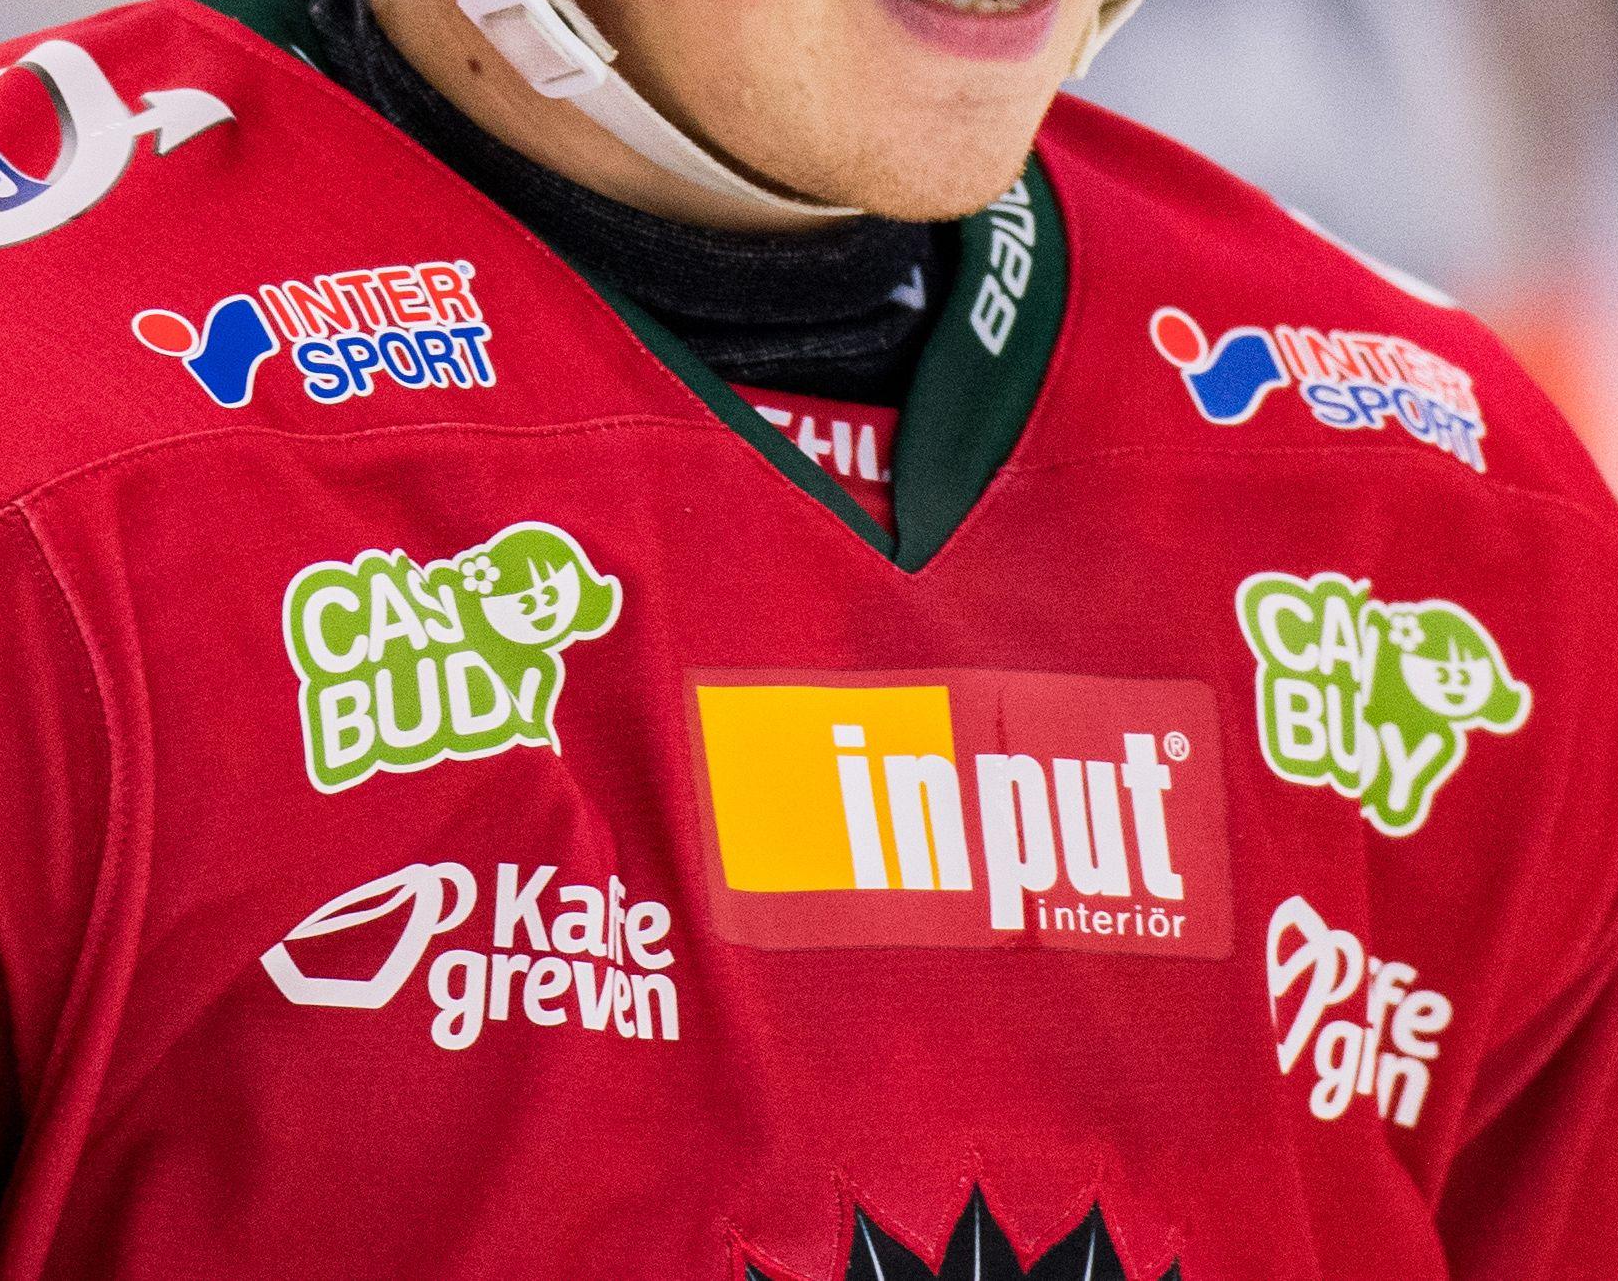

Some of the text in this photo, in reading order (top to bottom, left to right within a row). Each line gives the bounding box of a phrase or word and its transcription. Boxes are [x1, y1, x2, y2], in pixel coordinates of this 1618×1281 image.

[263, 263, 481, 340] INTER
[295, 324, 491, 401] SPORT
[1305, 382, 1485, 470] SPORT
[1037, 898, 1186, 939] interiör
[427, 948, 680, 1051] greven
